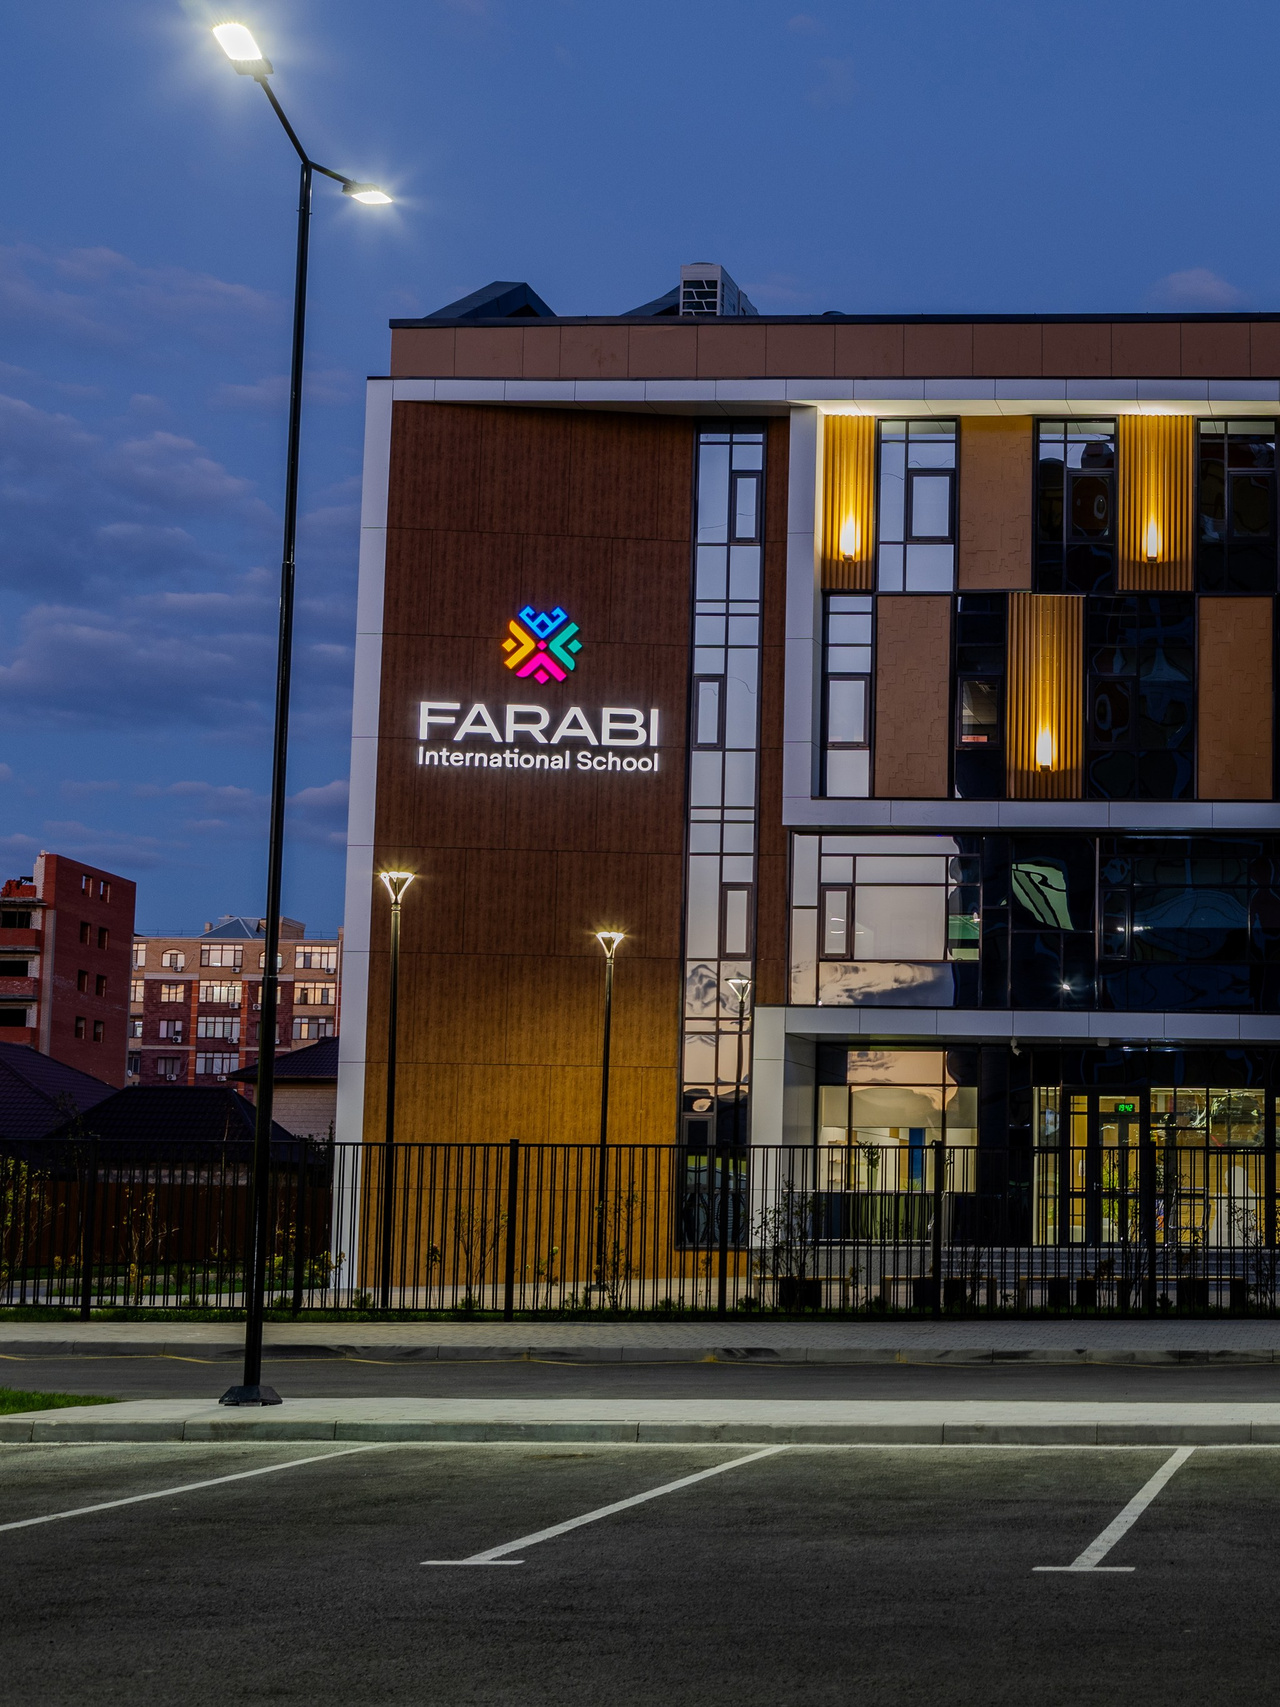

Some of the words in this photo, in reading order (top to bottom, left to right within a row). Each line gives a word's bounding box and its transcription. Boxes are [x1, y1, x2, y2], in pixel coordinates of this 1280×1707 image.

[419, 701, 659, 747] FARABI
[418, 746, 570, 770] International
[576, 751, 659, 772] School
